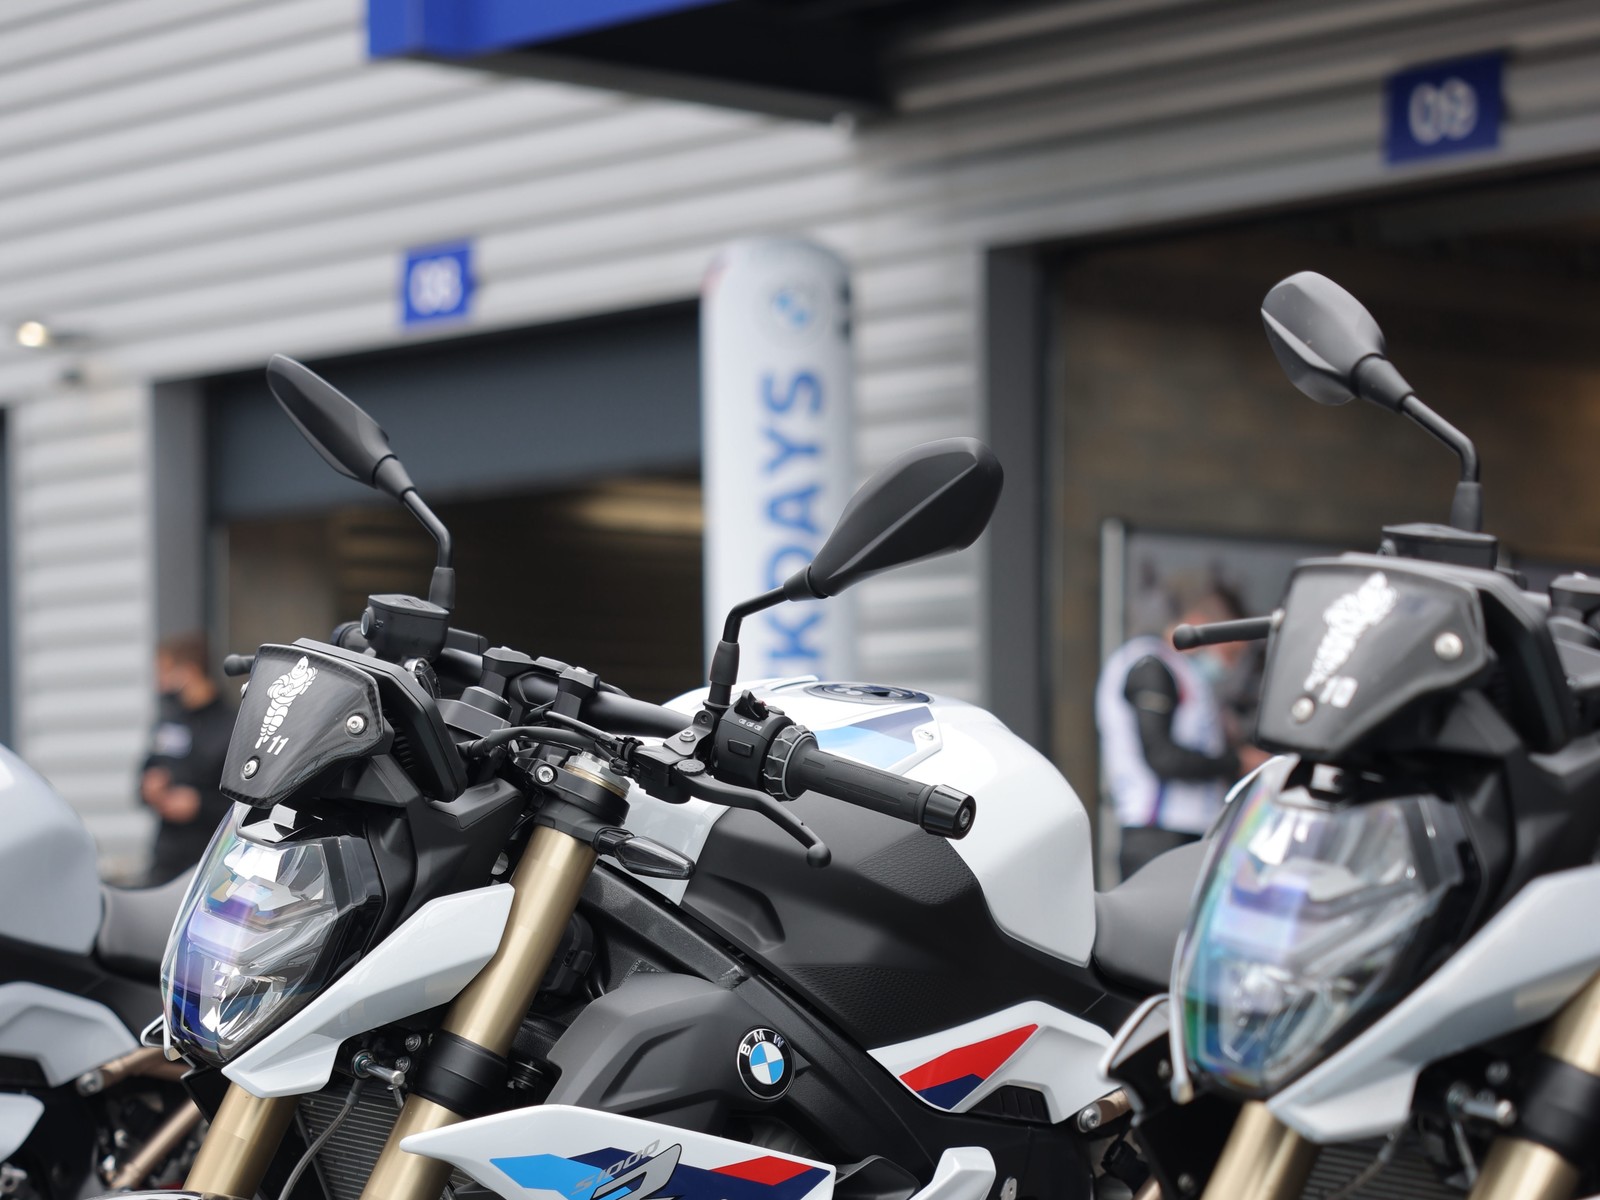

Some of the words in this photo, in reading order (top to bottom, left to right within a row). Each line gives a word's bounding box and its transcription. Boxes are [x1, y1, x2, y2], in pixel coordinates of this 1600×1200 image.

[1408, 79, 1478, 145] 09
[266, 735, 289, 755] 11
[740, 1030, 785, 1057] BMW
[569, 1139, 661, 1196] S1000
